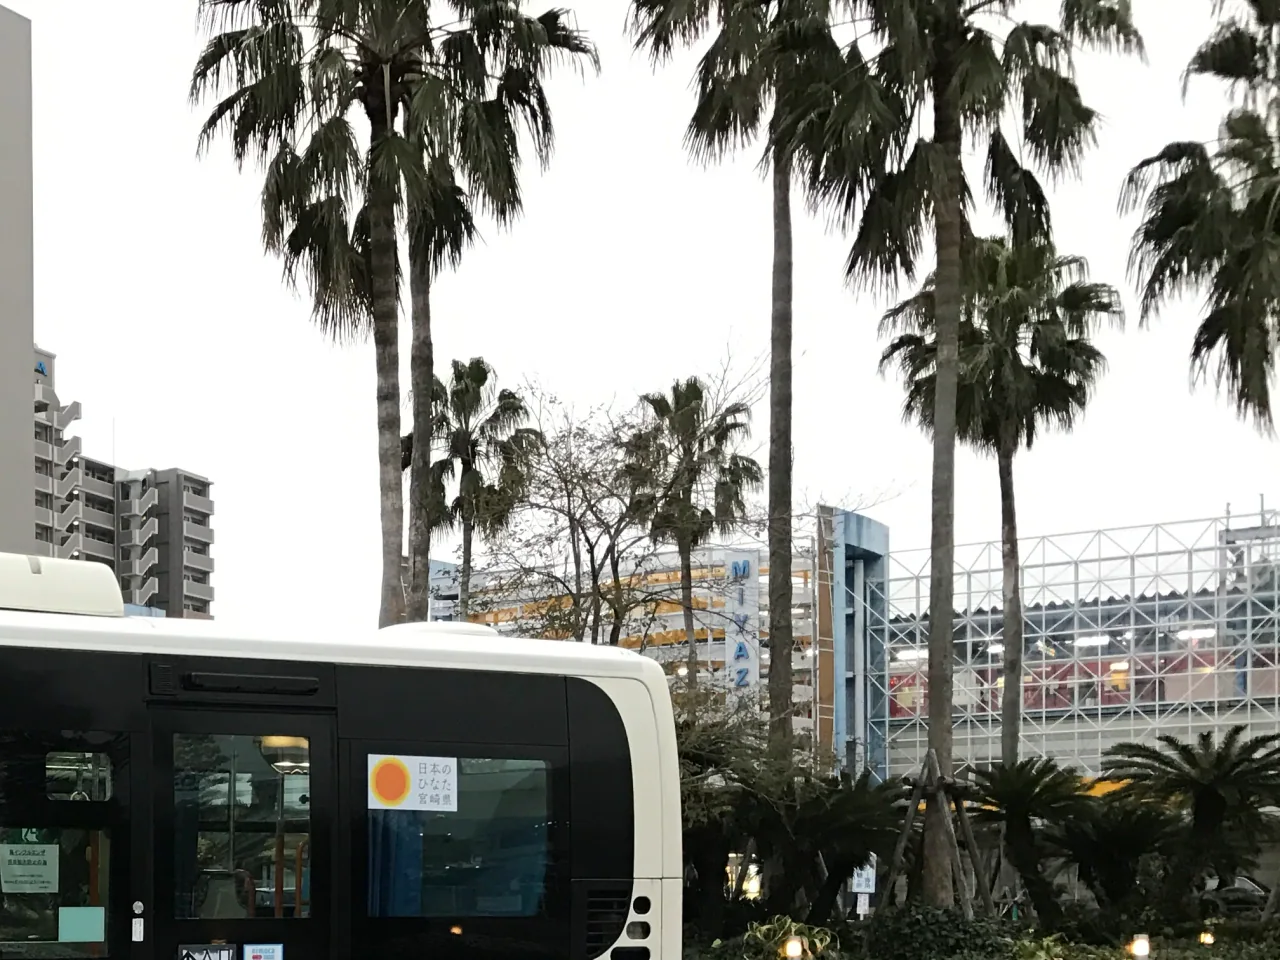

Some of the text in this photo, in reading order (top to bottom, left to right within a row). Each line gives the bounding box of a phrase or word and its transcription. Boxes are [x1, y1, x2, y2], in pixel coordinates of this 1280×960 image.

[731, 559, 750, 711] MIYAZ
[418, 762, 452, 776] 日本の
[418, 777, 451, 791] ひなた
[418, 792, 452, 806] 宮崎県
